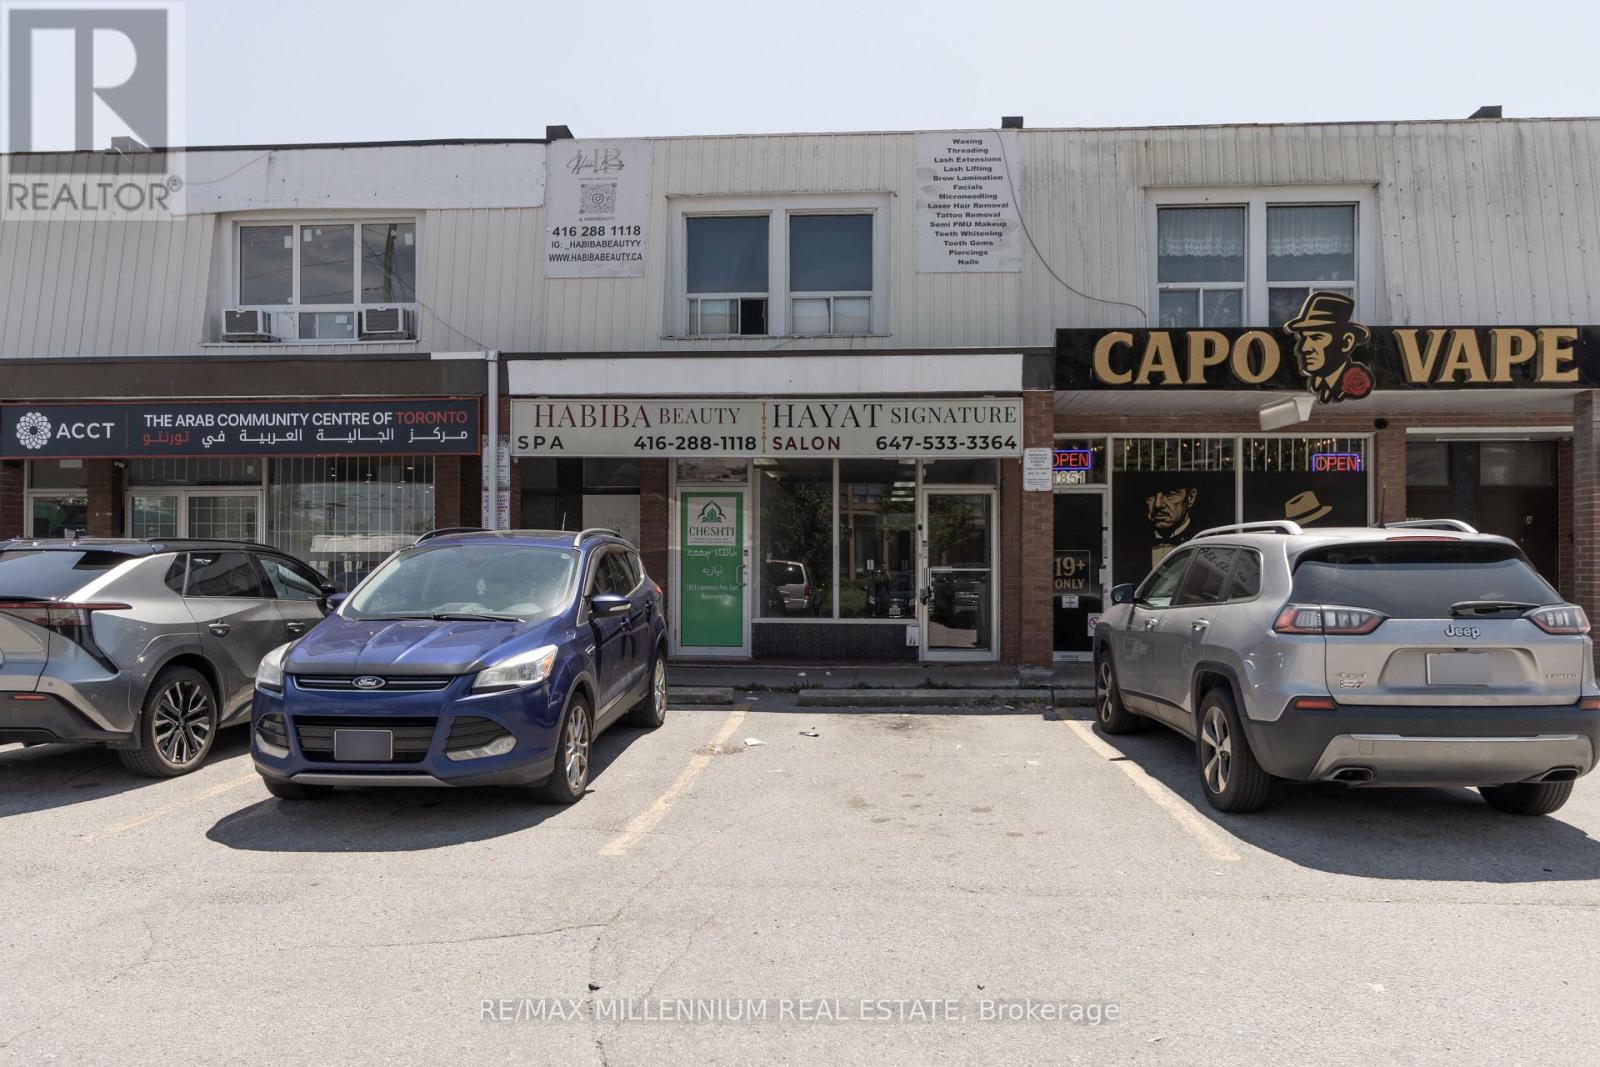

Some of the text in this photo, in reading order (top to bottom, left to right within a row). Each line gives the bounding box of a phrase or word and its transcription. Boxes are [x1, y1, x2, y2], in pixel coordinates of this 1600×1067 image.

[966, 165, 992, 173] Lifting
[552, 225, 641, 237] 416 288 1118
[548, 252, 643, 262] WWW.HABIBABEAUTY.CA
[1092, 327, 1580, 386] CAPO VAPE
[144, 410, 468, 427] THE ARAB COMMUNITY CENTRE OF TORONTO
[534, 404, 741, 428] HABIBA BEAUTY
[773, 403, 1016, 428] HAYAT SIGNATURE
[56, 422, 115, 439] ACCT
[143, 426, 468, 448] مركز الجالية العربية في تورنتو
[517, 435, 757, 450] SPA 416-288-1118
[772, 435, 1017, 450] SALON 647-533-3364
[1053, 452, 1089, 467] OPEN
[1314, 456, 1357, 472] OPEN
[689, 527, 734, 537] CHESHTI
[1055, 556, 1086, 577] 19+
[1055, 578, 1085, 589] ONLY
[1444, 624, 1481, 639] Jeep
[358, 678, 377, 686] Ford
